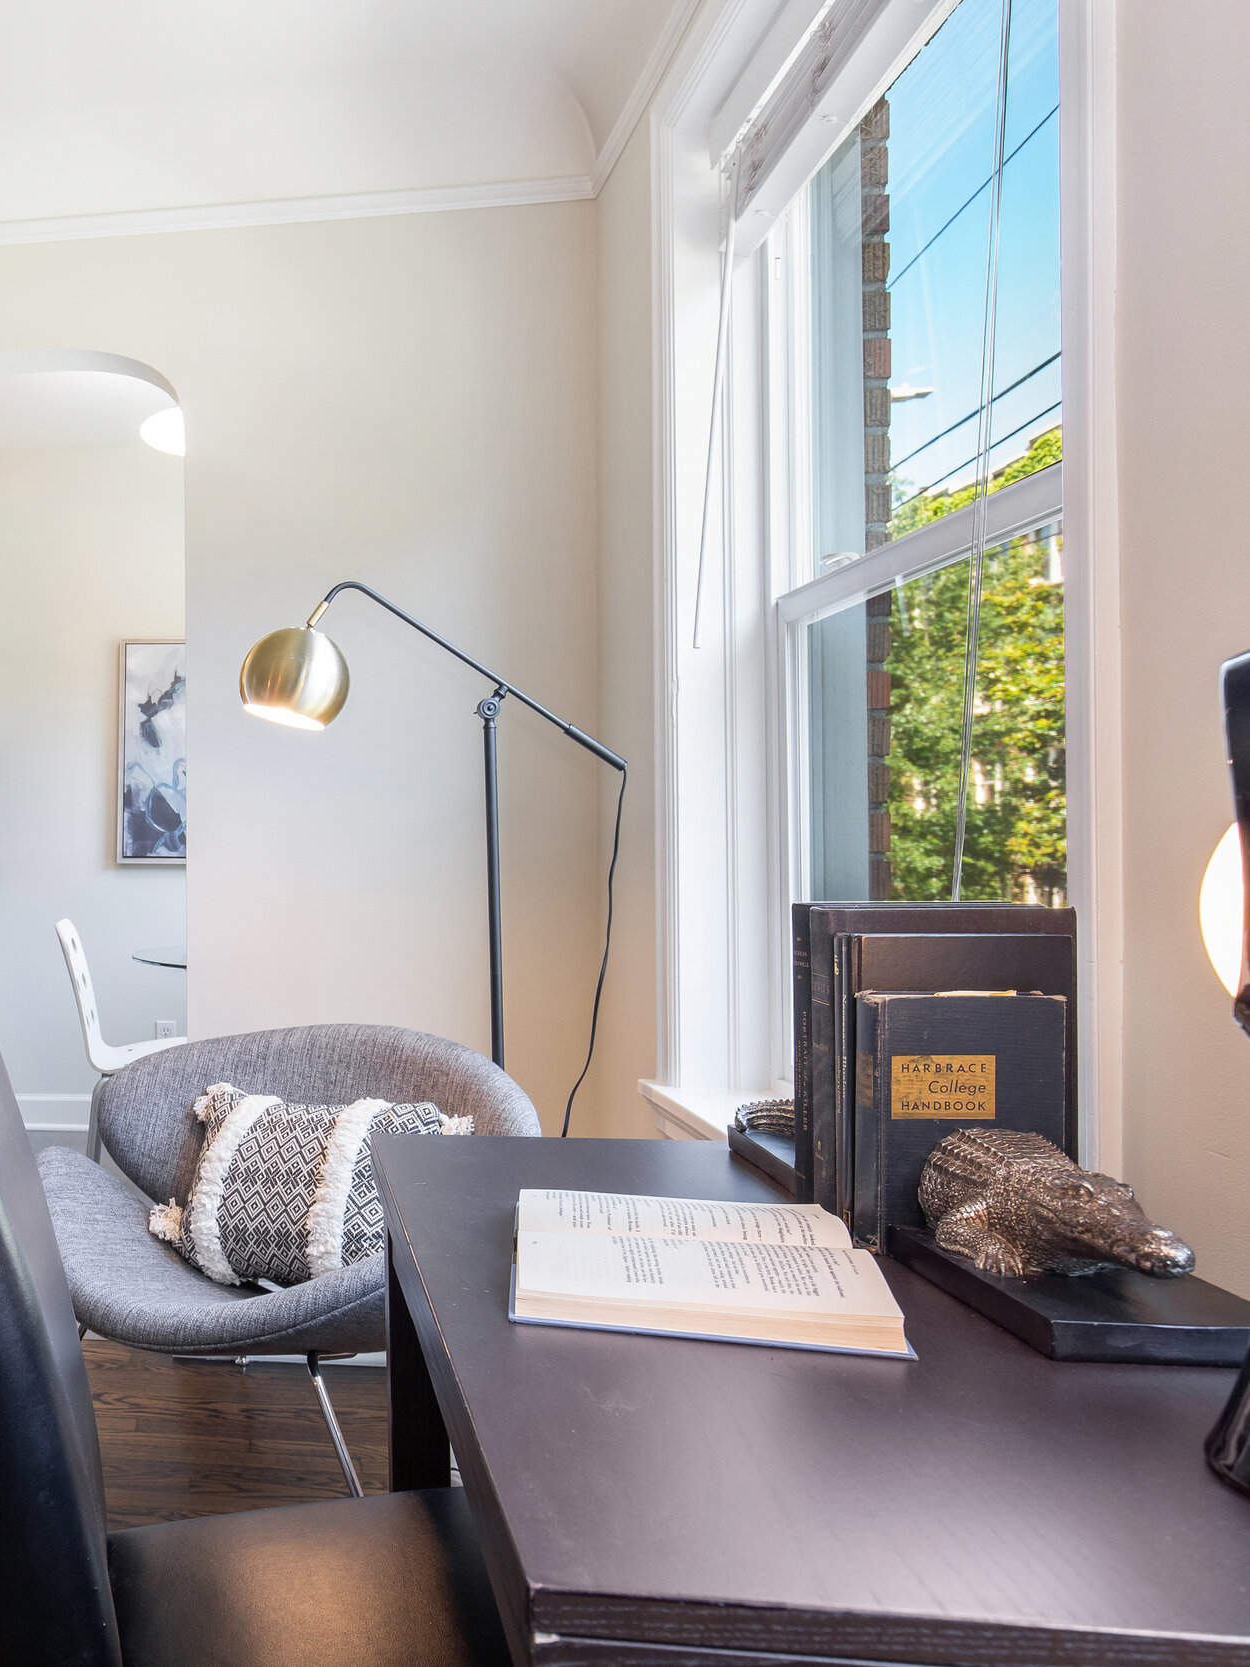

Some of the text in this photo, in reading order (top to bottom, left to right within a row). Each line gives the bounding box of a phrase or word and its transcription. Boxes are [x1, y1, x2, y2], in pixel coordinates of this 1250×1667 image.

[901, 1063, 987, 1073] HARBRACE
[928, 1079, 987, 1096] College
[901, 1101, 986, 1111] HANDBOOK
